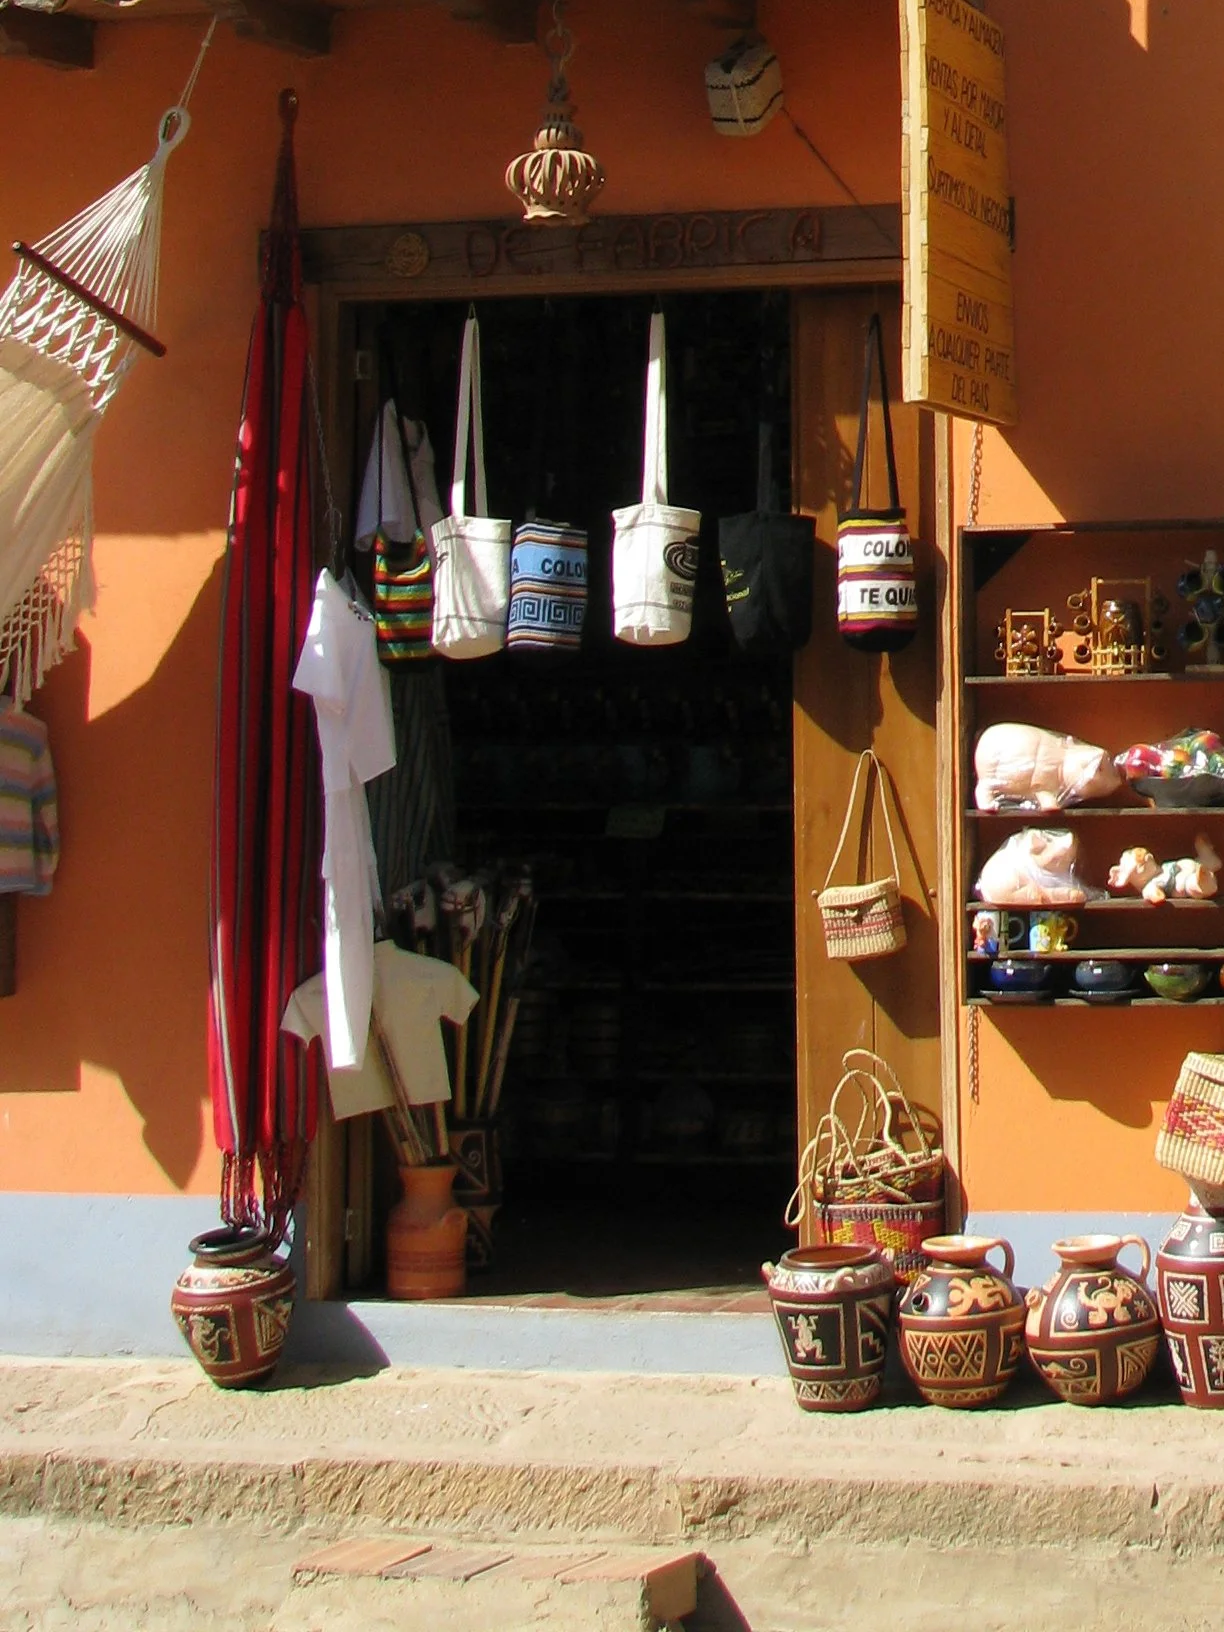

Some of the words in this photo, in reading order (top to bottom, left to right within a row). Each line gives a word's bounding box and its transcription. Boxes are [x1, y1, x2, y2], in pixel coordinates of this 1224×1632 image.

[968, 15, 1006, 58] ALMACEN
[928, 56, 959, 100] VENTAS
[961, 76, 978, 109] POR
[979, 90, 1005, 132] MAYOR
[943, 107, 950, 131] Y
[951, 112, 963, 144] AL
[964, 120, 988, 159] DETAL
[928, 155, 966, 210] SURTIMOS
[968, 185, 978, 218] SU
[576, 212, 822, 274] FABRICA
[956, 291, 989, 335] ENVIOS
[936, 327, 981, 370] CUALQUIER
[983, 347, 1010, 381] PARTE
[951, 373, 967, 405] DEL
[540, 558, 586, 578] COLO
[859, 587, 880, 605] TE
[885, 587, 915, 606] QUI
